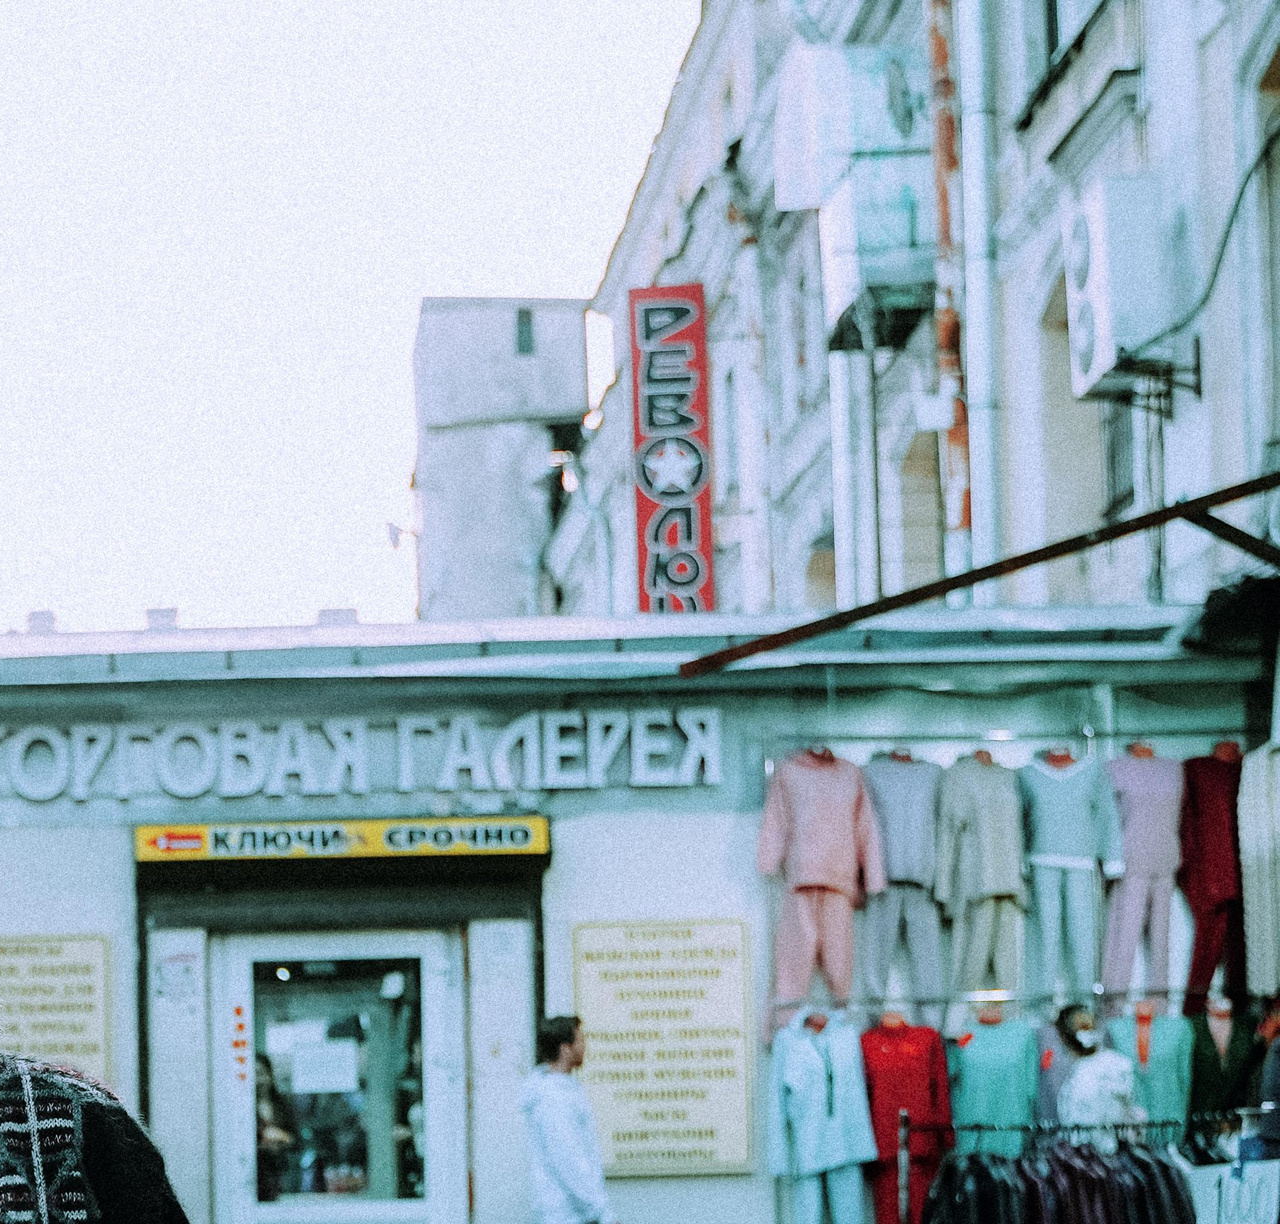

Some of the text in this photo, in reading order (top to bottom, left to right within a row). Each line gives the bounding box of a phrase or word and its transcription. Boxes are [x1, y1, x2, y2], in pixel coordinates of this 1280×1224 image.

[396, 708, 721, 794] ГАЛЕРЕЯ
[212, 826, 531, 852] КЛЮЧИ СРОЧНО
